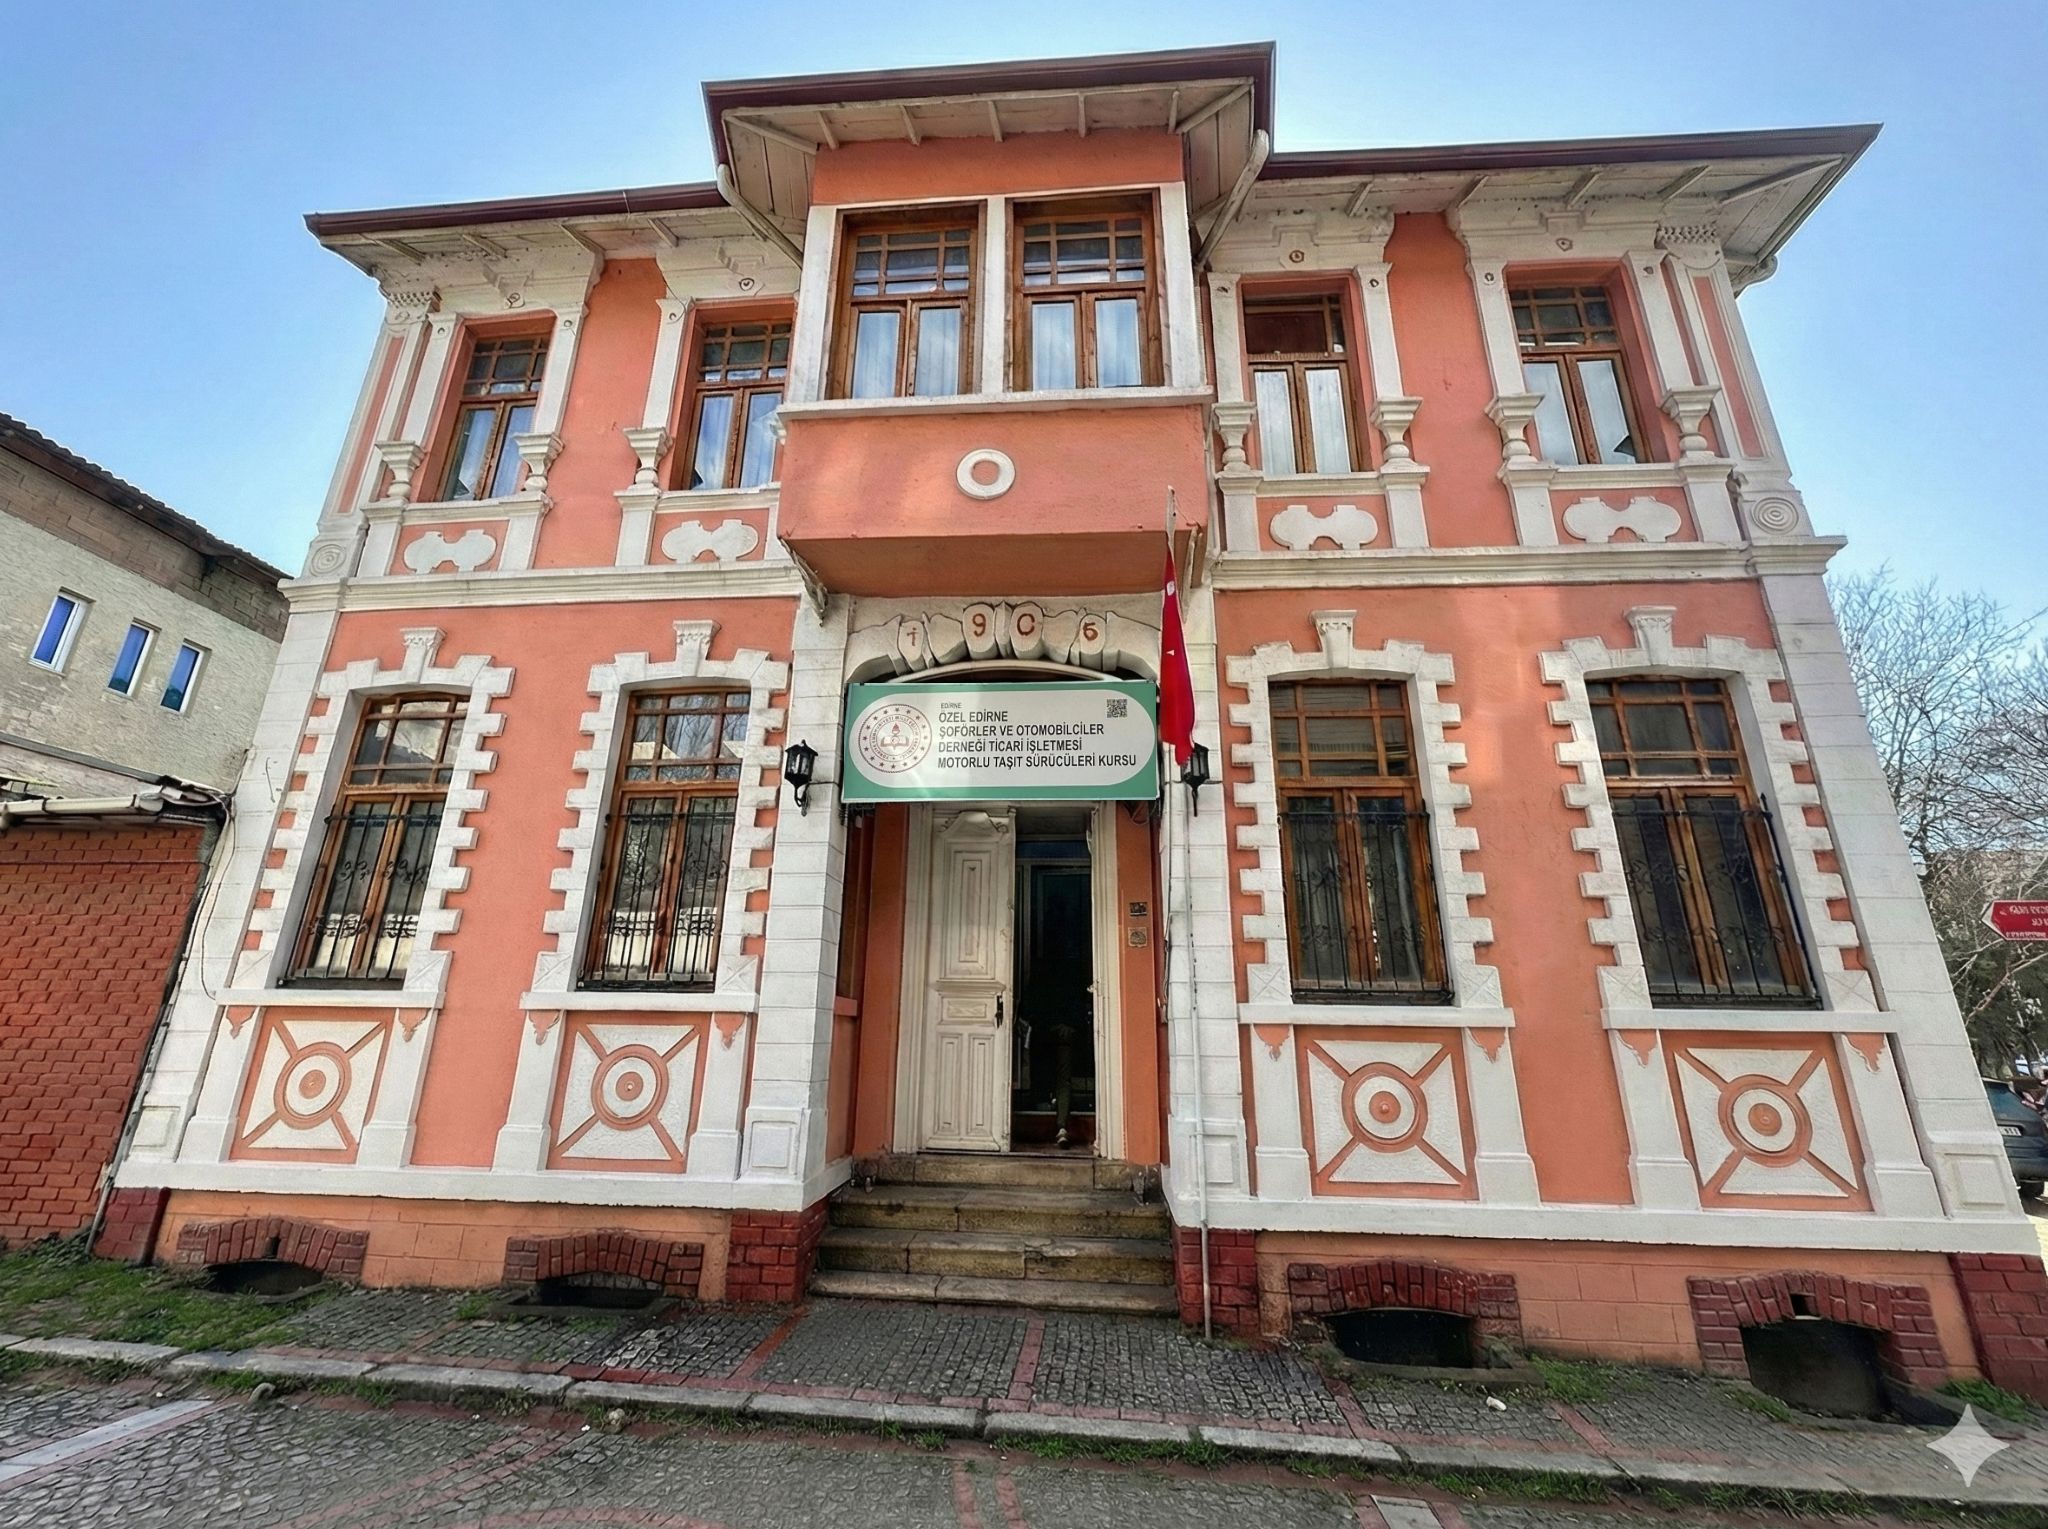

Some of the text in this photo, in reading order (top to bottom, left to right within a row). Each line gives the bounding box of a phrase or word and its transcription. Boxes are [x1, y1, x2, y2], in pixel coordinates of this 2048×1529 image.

[938, 708, 1008, 723] ÖZEL EDİRNE
[939, 721, 1104, 739] ŞOFÖRLER VE OTOMOBİLCİLER
[938, 737, 1082, 754] DERNEĞİ TİCARİ İŞLETMESİ
[937, 752, 1136, 771] MOTORLU TAŞIT SÜRÜCÜLERİ KURSU
